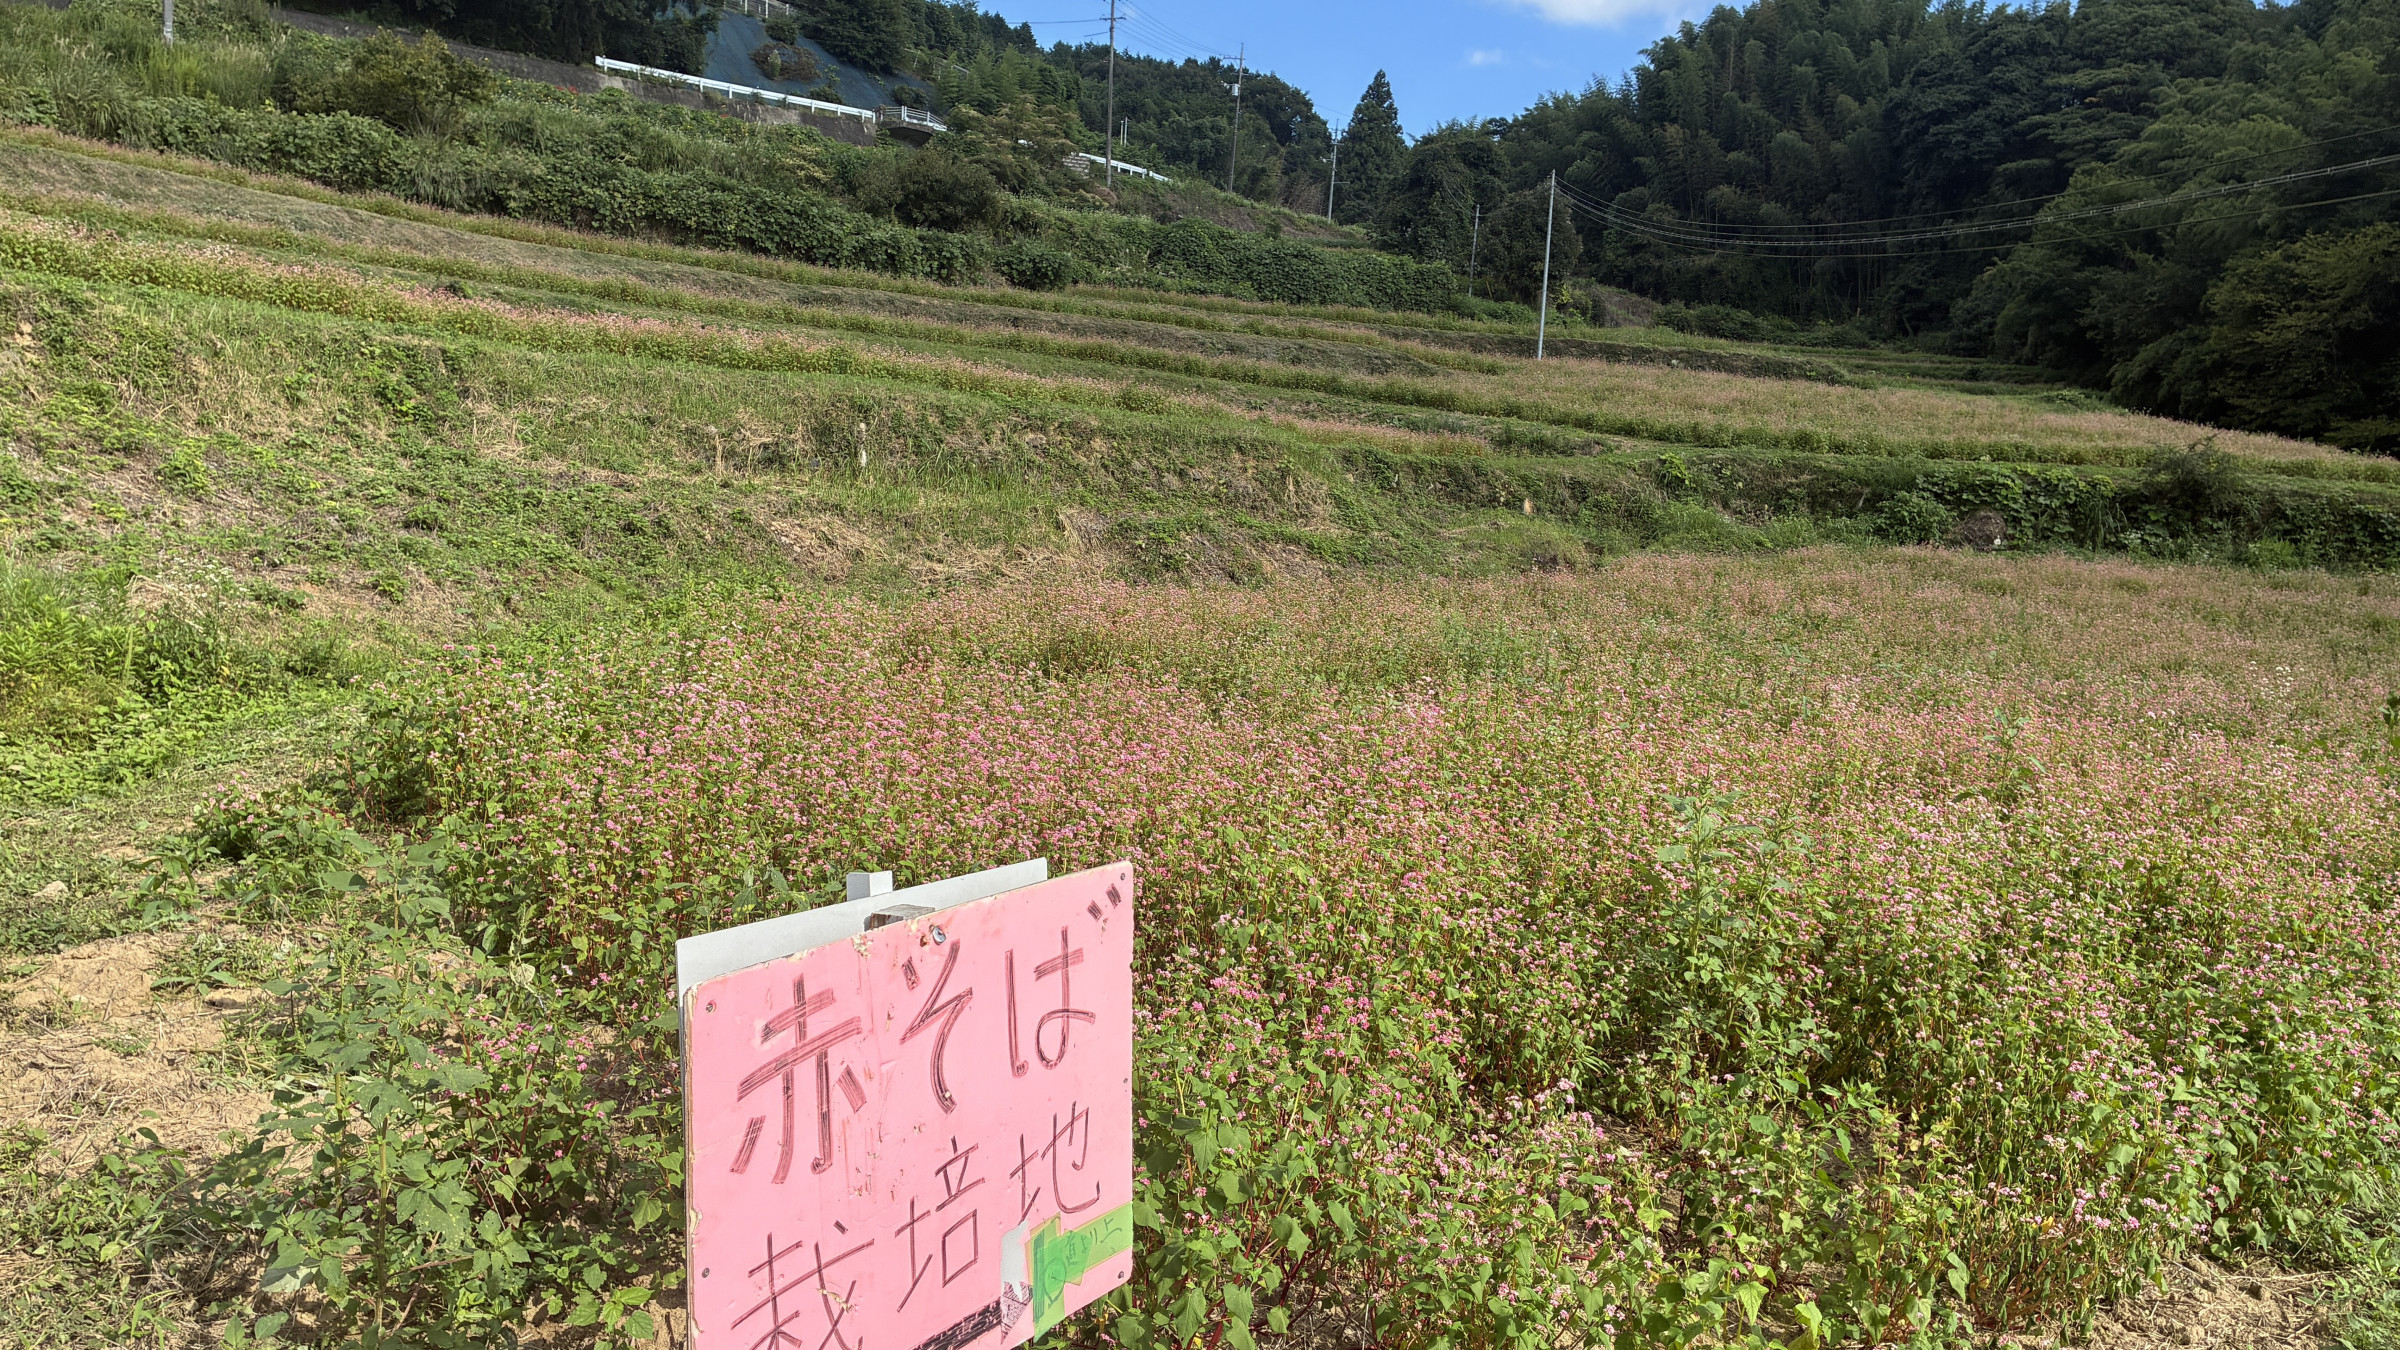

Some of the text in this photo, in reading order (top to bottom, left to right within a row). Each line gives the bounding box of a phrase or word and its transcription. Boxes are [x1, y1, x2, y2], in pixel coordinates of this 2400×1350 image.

[729, 883, 1122, 1185] 赤そば
[730, 1101, 1101, 1350] 栽培地
